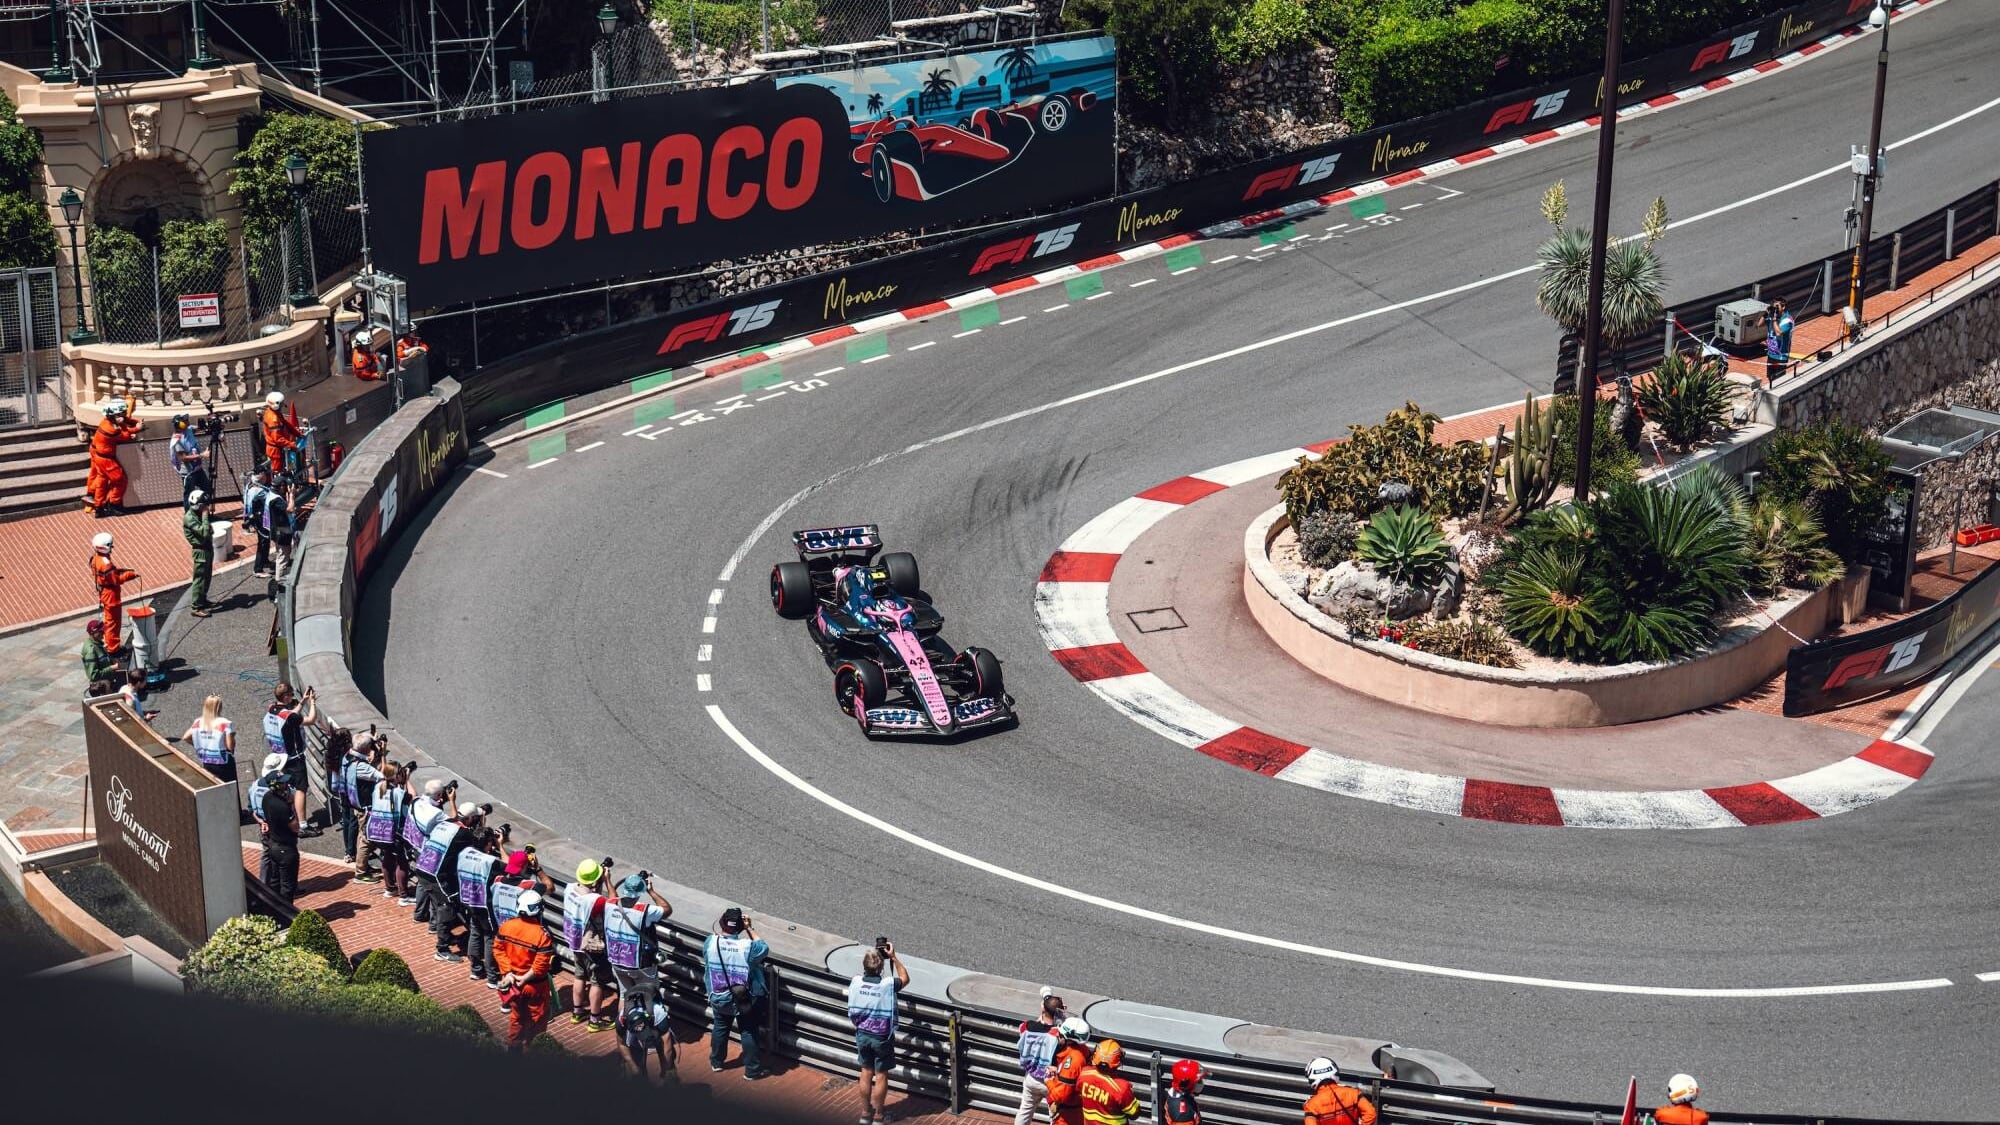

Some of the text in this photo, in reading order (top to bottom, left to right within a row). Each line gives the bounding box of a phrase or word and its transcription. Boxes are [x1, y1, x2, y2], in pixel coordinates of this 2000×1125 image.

[1778, 14, 1815, 48] Monaco
[1371, 134, 1430, 172] Monaco
[419, 117, 822, 264] MONACO
[1117, 202, 1183, 242] Monaco
[823, 277, 898, 320] Monaco
[636, 379, 829, 440] TAXIS
[417, 430, 460, 490] Monaco
[807, 528, 865, 548] BWT
[106, 775, 173, 865] Fairmont
[122, 831, 160, 872] MONTE CARLO
[1081, 1082, 1110, 1105] CSPM
